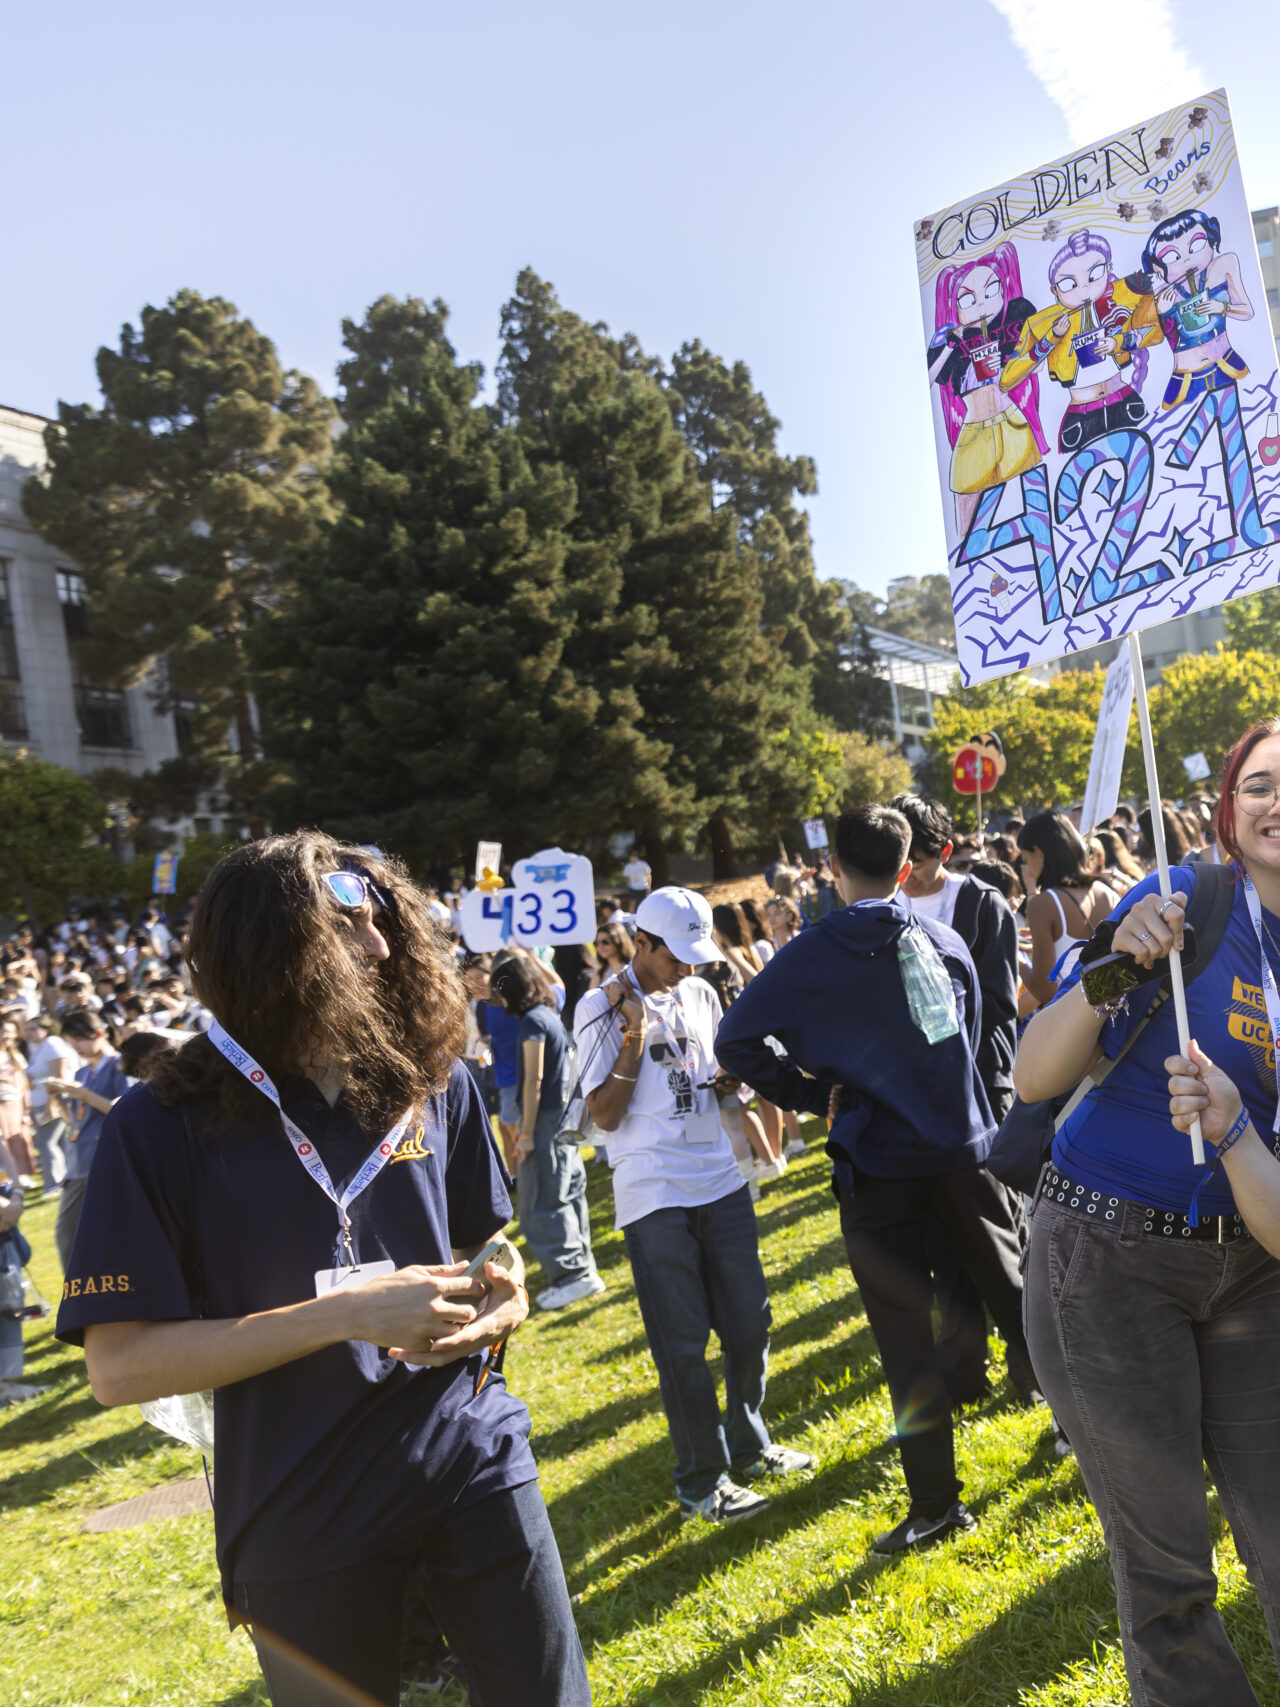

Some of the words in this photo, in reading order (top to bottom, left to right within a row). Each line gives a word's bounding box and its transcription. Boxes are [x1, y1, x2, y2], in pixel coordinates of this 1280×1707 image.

[1144, 141, 1211, 195] Bears
[932, 127, 1150, 260] GOLDEN
[974, 346, 999, 362] MIRA
[1074, 333, 1100, 349] RUMI
[482, 889, 578, 935] 433
[1242, 1022, 1266, 1042] UC
[219, 1038, 247, 1068] Berkeley
[348, 1162, 379, 1197] Berkeley
